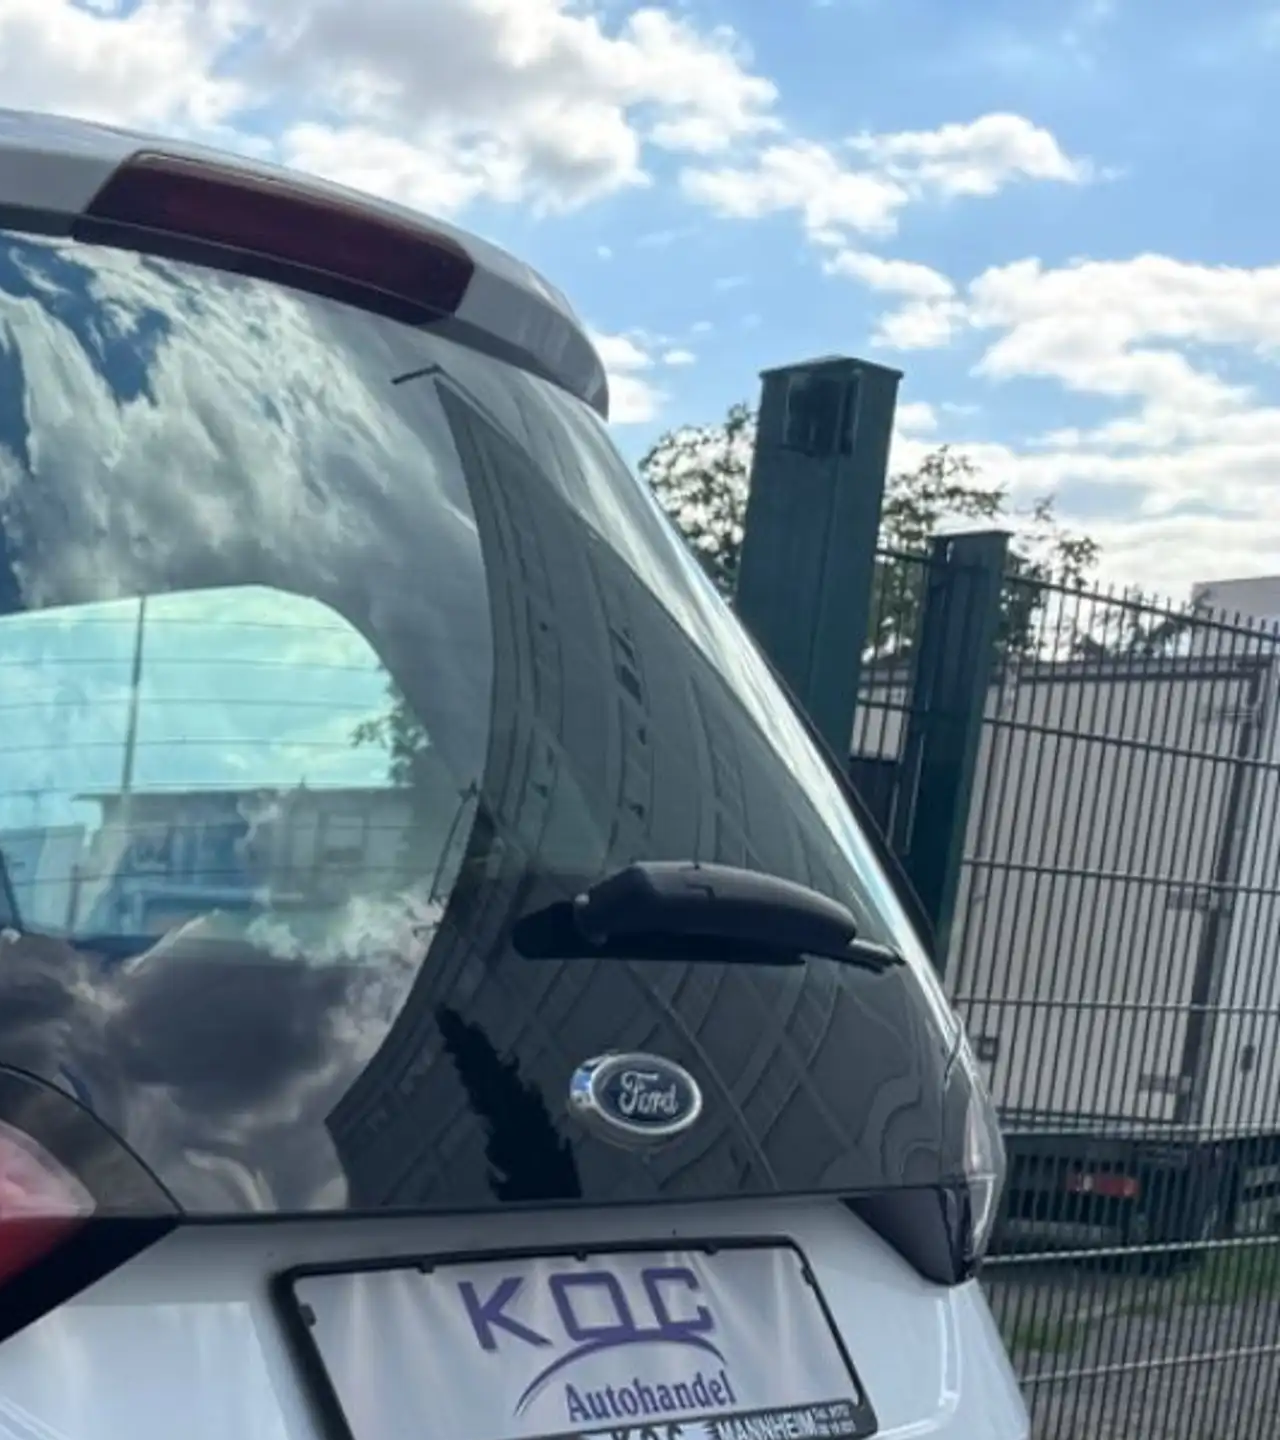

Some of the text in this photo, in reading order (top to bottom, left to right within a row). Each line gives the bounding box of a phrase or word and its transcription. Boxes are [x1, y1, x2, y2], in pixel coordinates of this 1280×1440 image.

[618, 1070, 679, 1115] Ford
[457, 1267, 714, 1354] KOC
[565, 1369, 737, 1423] Autohandel
